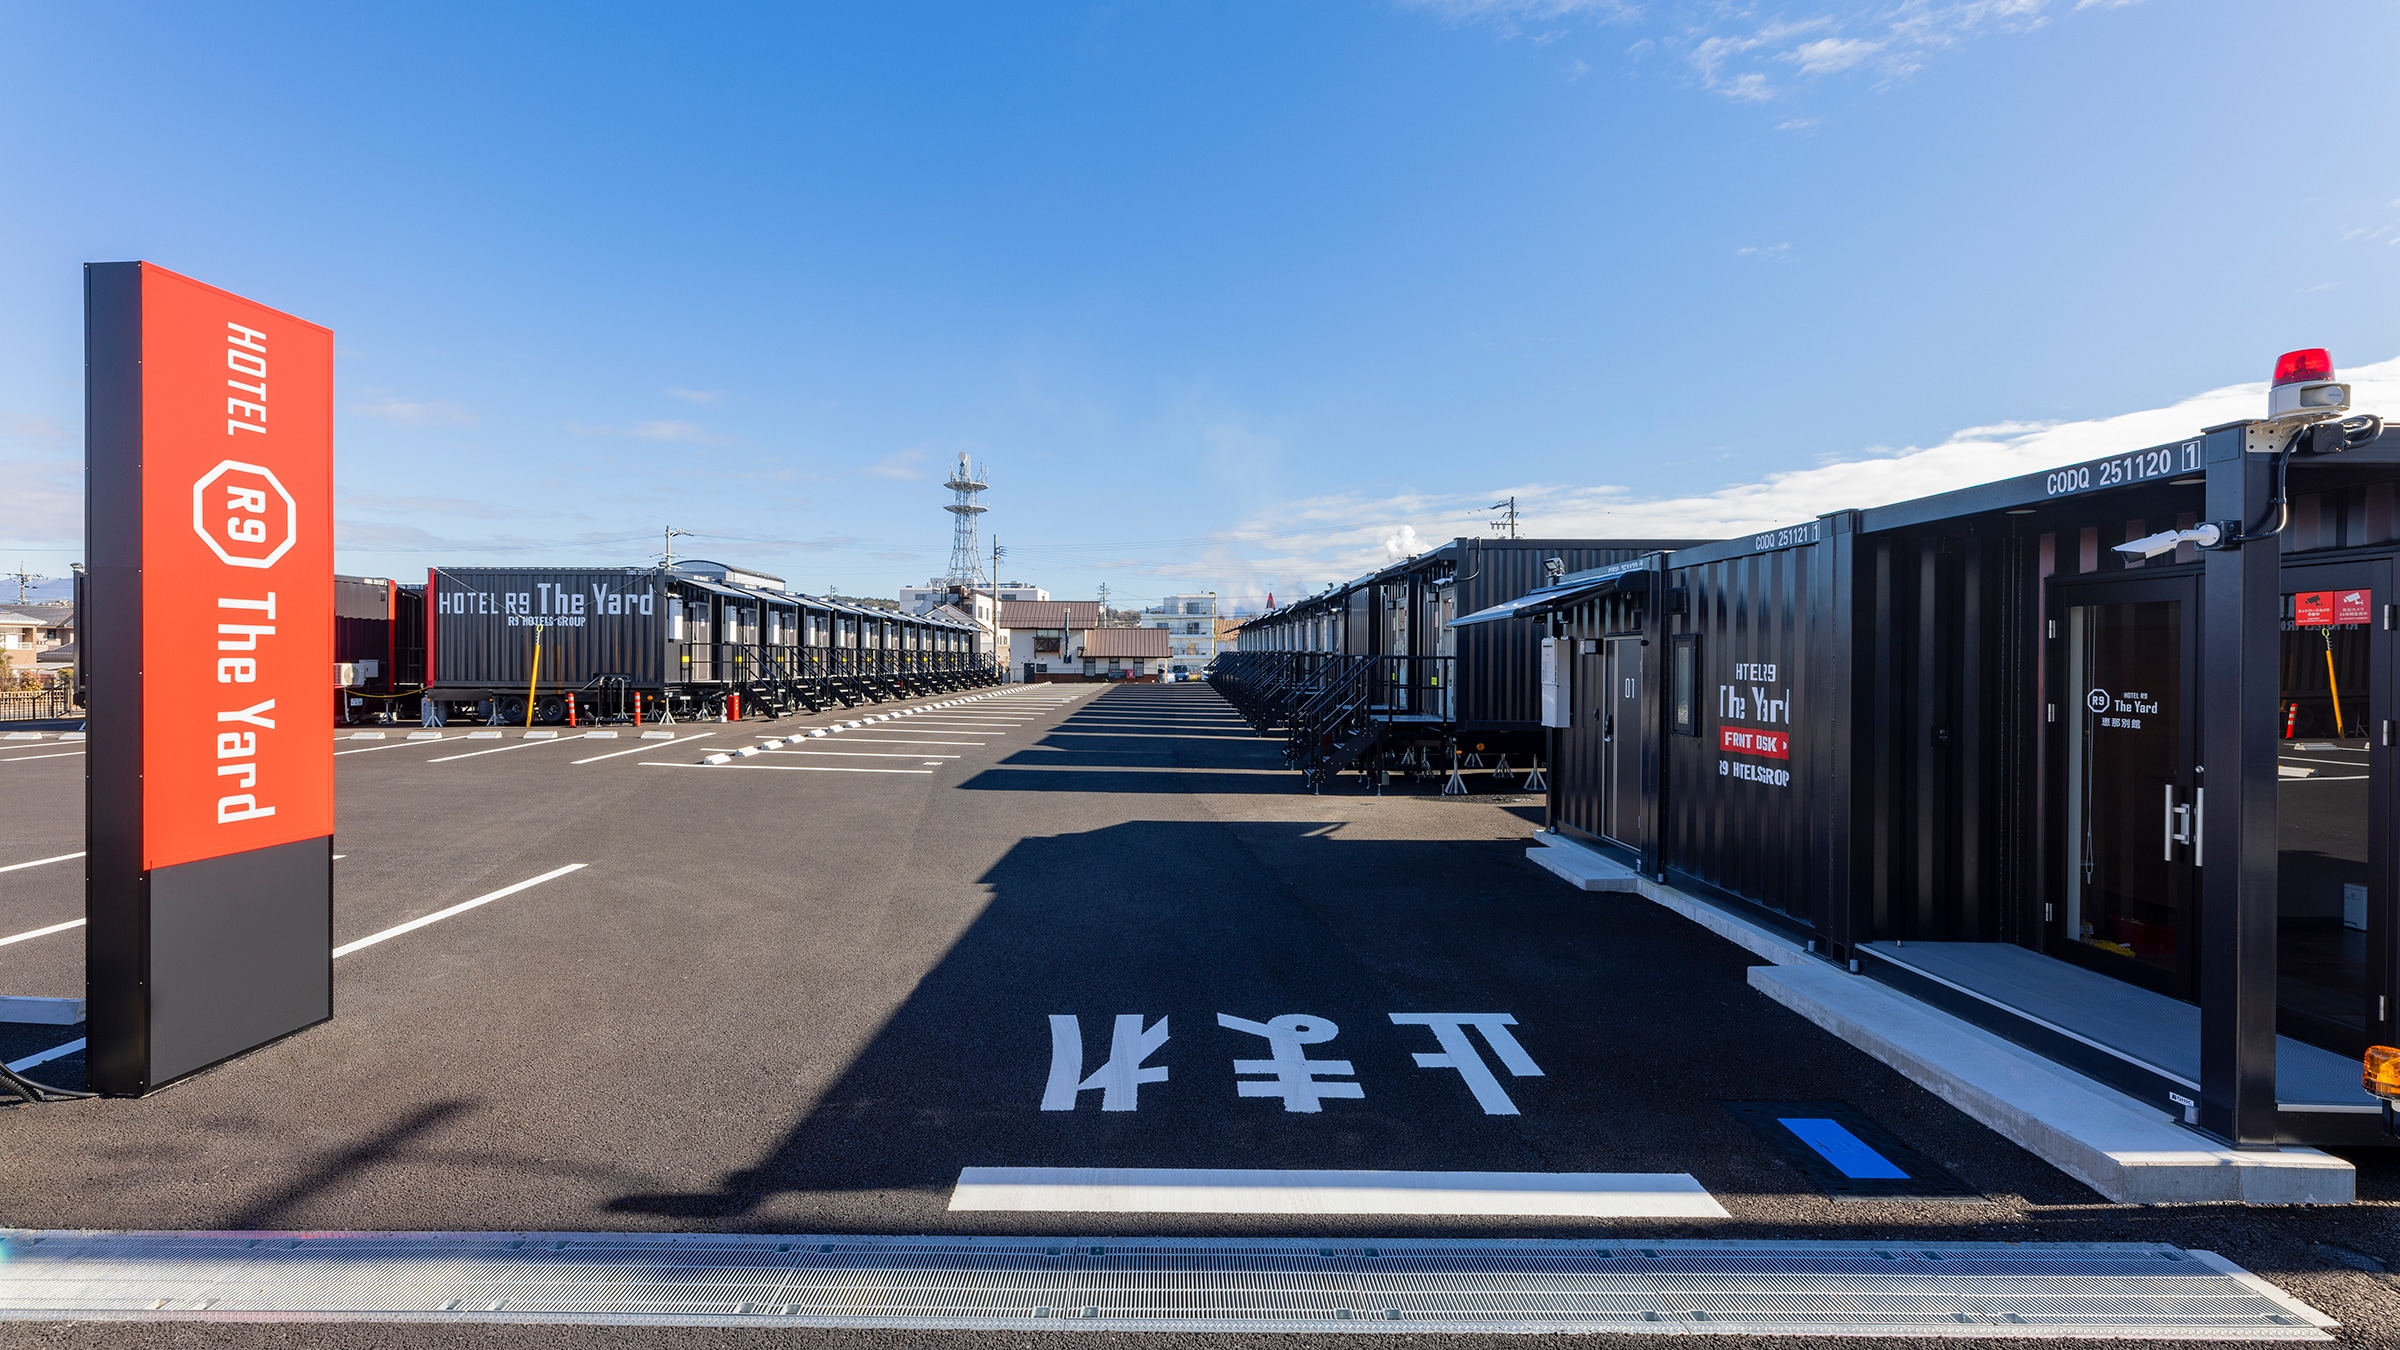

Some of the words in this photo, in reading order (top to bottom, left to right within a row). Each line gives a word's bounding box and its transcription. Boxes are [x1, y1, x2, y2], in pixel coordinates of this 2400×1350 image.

[227, 321, 267, 436] HOTEL
[2047, 467, 2089, 495] CODQ
[2099, 449, 2171, 486] 251120
[2184, 442, 2197, 469] 1
[227, 485, 267, 544] R9
[1755, 533, 1775, 550] CODQ
[1778, 526, 1807, 547] 251121
[439, 592, 498, 614] HOTEL
[506, 592, 529, 614] R9
[537, 583, 584, 615] The
[592, 583, 653, 615] Yard
[508, 616, 519, 627] R9
[522, 616, 554, 627] HOTELS
[557, 616, 586, 627] GROUP
[217, 591, 276, 684] The
[1735, 663, 1763, 681] HTEL
[1625, 678, 1634, 698] 01
[2092, 696, 2105, 706] R9
[2114, 699, 2132, 712] The
[2134, 700, 2158, 714] Yard
[1725, 731, 1753, 749] FRNT
[1756, 734, 1777, 752] DSK
[217, 698, 276, 825] Yard
[1733, 761, 1763, 782] HTELS
[1039, 1012, 1545, 1116] 止まれ
